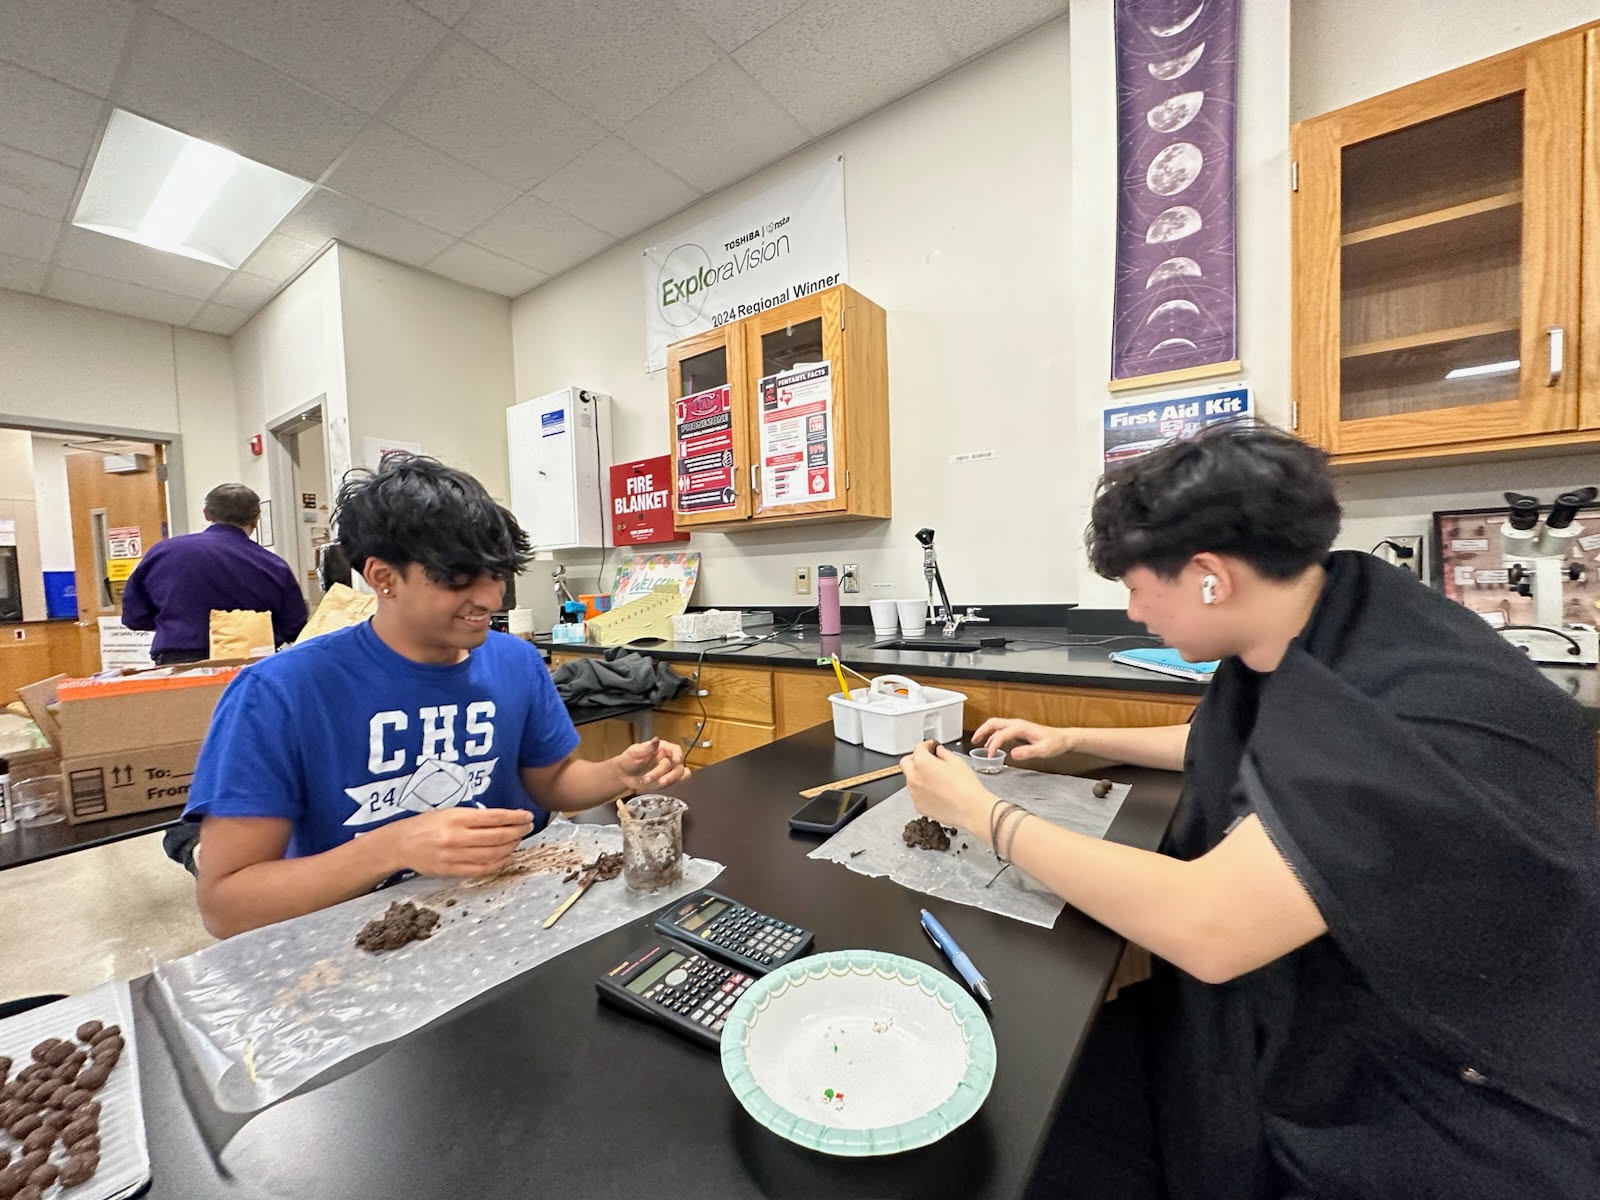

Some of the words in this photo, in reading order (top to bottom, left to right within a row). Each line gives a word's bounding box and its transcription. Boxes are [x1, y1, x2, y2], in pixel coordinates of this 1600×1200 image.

[724, 230, 760, 251] TOSHIBA
[774, 216, 790, 230] nsta
[662, 234, 790, 307] ExploraVision
[712, 308, 736, 327] 2024
[738, 288, 789, 317] Regional
[793, 272, 840, 299] Winner
[807, 367, 826, 379] FACTS
[1110, 409, 1157, 428] First
[1160, 402, 1199, 421] Aid
[1205, 397, 1242, 416] Kit
[626, 473, 654, 495] FIRE
[614, 489, 669, 515] BLANKET
[367, 701, 496, 775] CHS
[370, 787, 396, 813] 24
